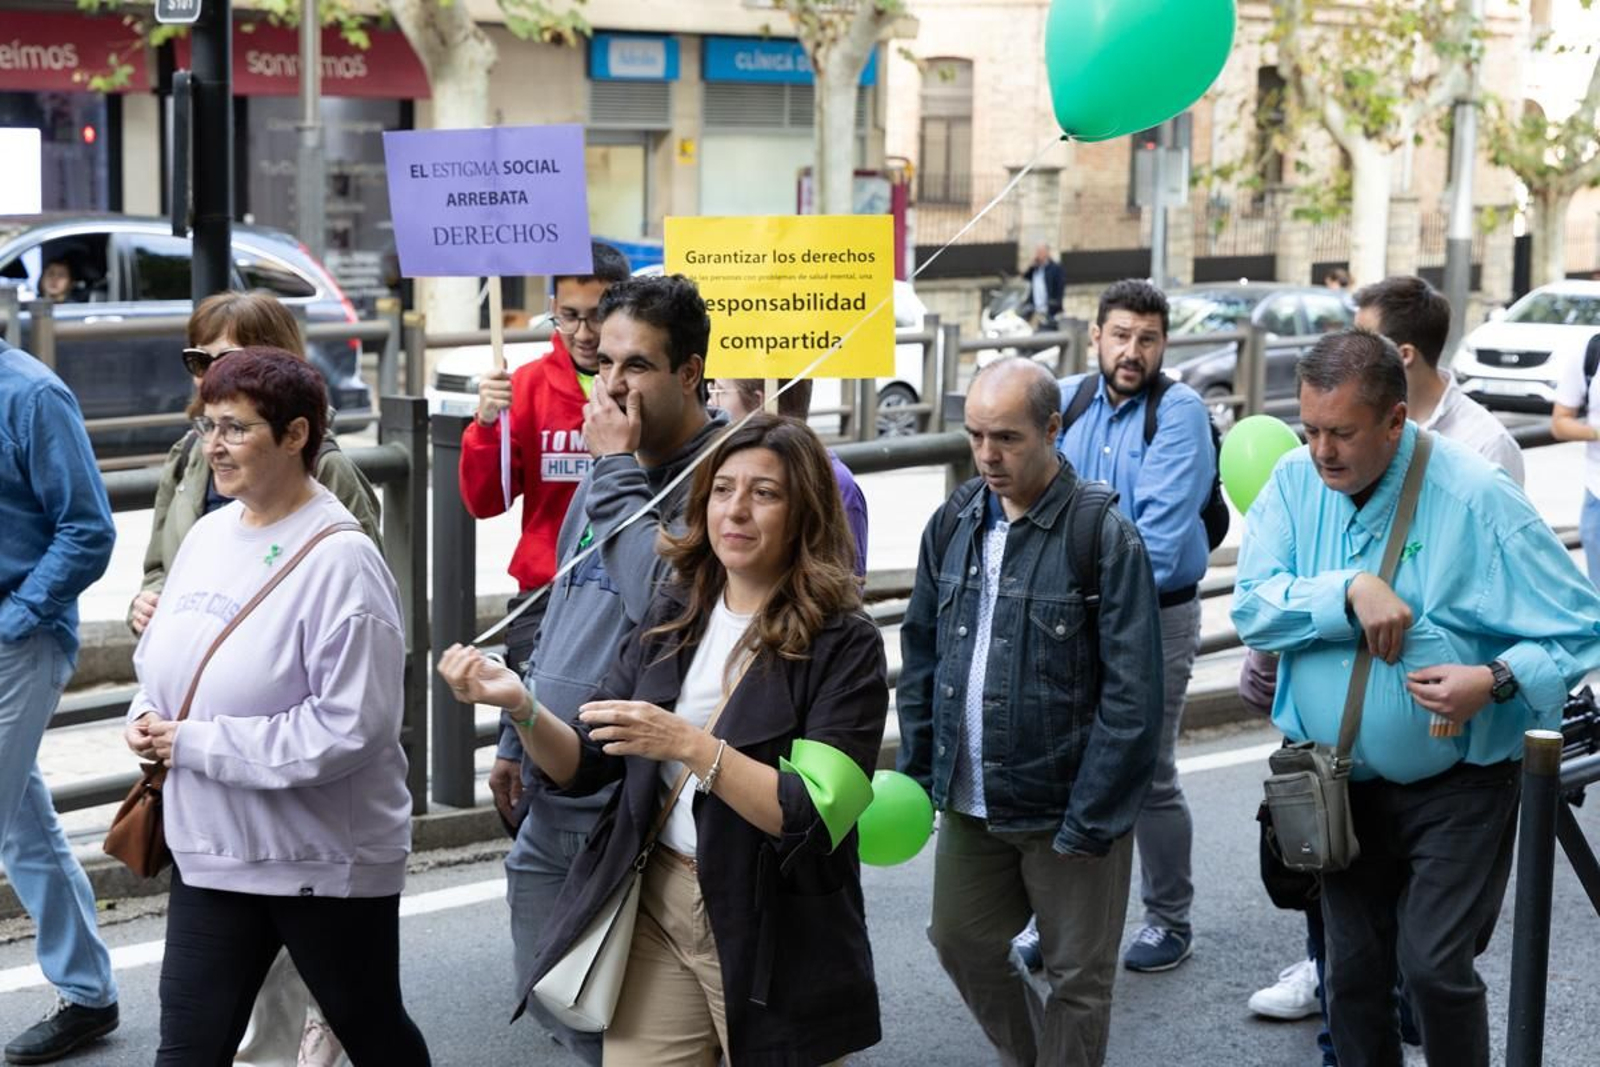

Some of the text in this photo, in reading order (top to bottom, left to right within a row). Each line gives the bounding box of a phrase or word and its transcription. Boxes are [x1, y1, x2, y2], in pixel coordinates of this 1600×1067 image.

[410, 159, 560, 178] EL ESTIGMA SOCIAL
[446, 190, 529, 207] ARREBATA
[433, 223, 559, 245] DERECHOS
[685, 249, 876, 264] Garantizar los derechos
[704, 291, 866, 316] esponsabilidad
[719, 330, 843, 354] compartida
